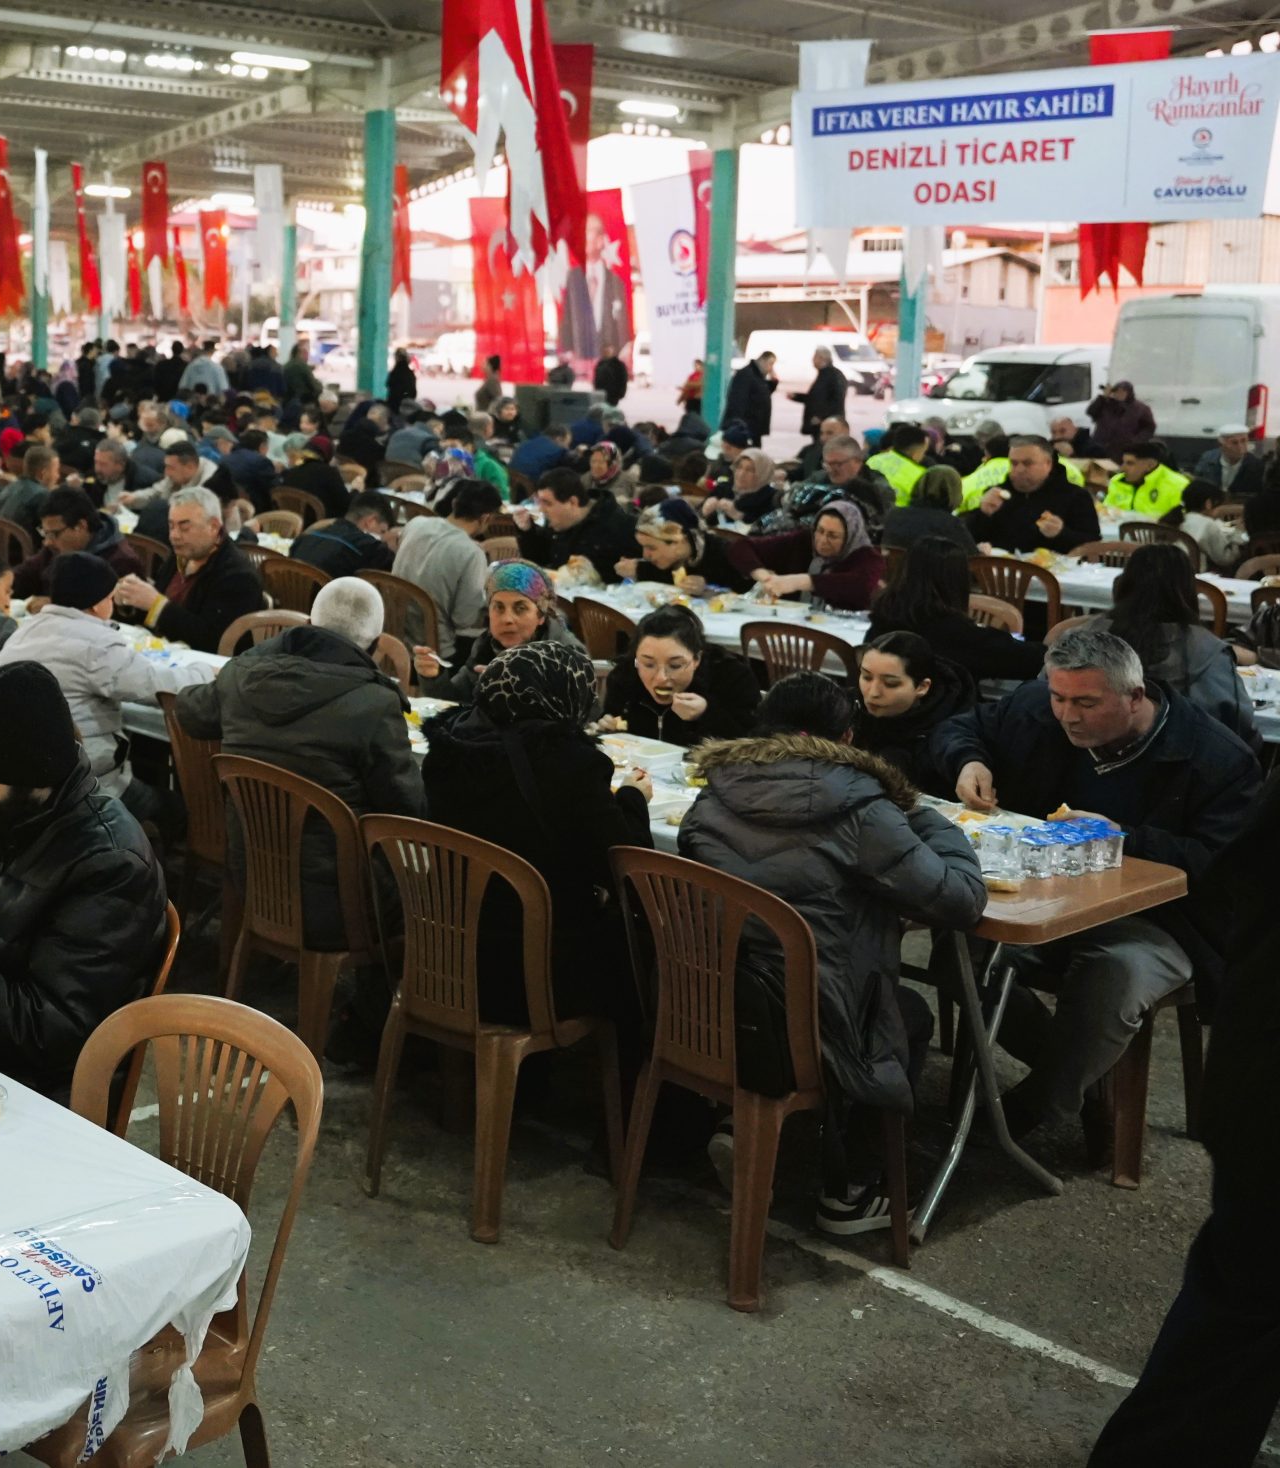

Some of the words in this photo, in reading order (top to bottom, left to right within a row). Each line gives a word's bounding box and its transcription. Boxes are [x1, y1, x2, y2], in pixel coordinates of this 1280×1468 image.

[818, 109, 875, 132] İFTAR
[877, 103, 946, 127] VEREN
[951, 99, 1020, 123] HAYIR
[1023, 88, 1105, 118] SAHİBİ
[1147, 83, 1264, 126] Ramazanlar
[848, 139, 946, 172] DENİZLİ
[956, 137, 1075, 167] TİCARET
[914, 179, 996, 205] ODASI
[12, 1269, 65, 1332] AFİYET
